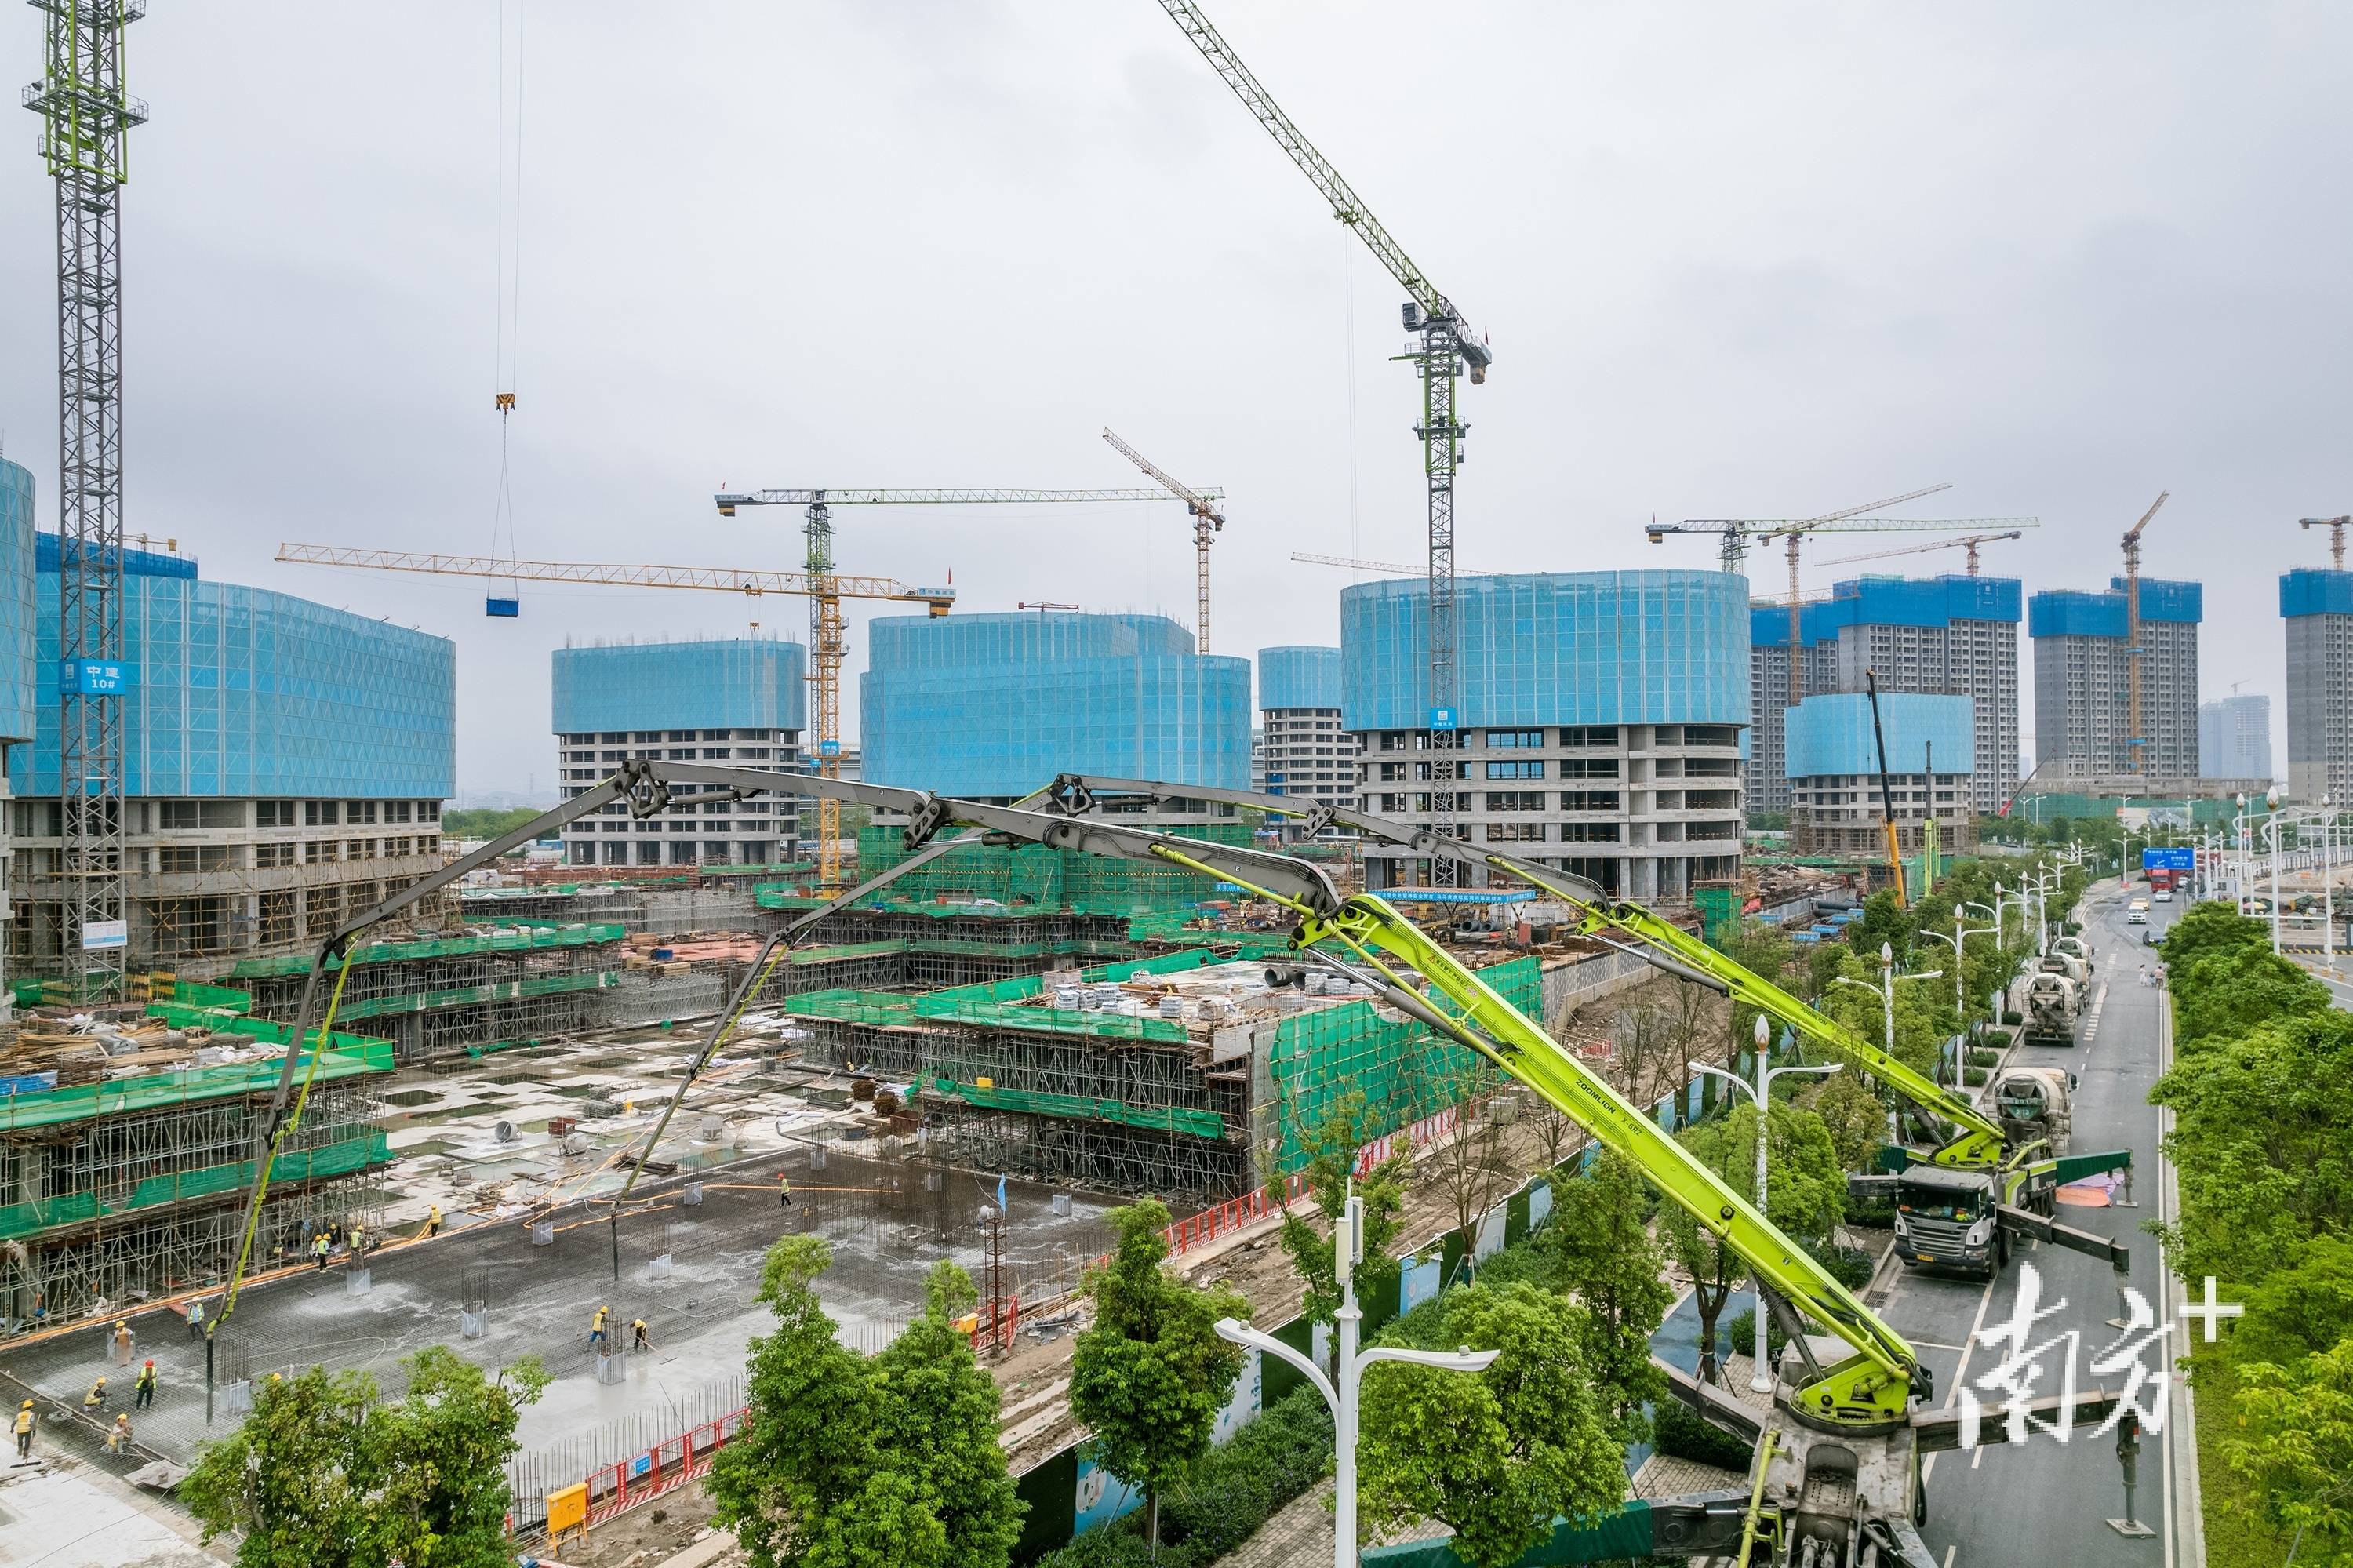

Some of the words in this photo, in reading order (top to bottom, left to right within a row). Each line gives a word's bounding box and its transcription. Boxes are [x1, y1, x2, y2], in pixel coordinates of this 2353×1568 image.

[86, 666, 120, 679] 中建
[92, 679, 115, 689] 10#
[1801, 1006, 1827, 1026] ZOOMLION
[1575, 1079, 1616, 1114] ZOOMLION
